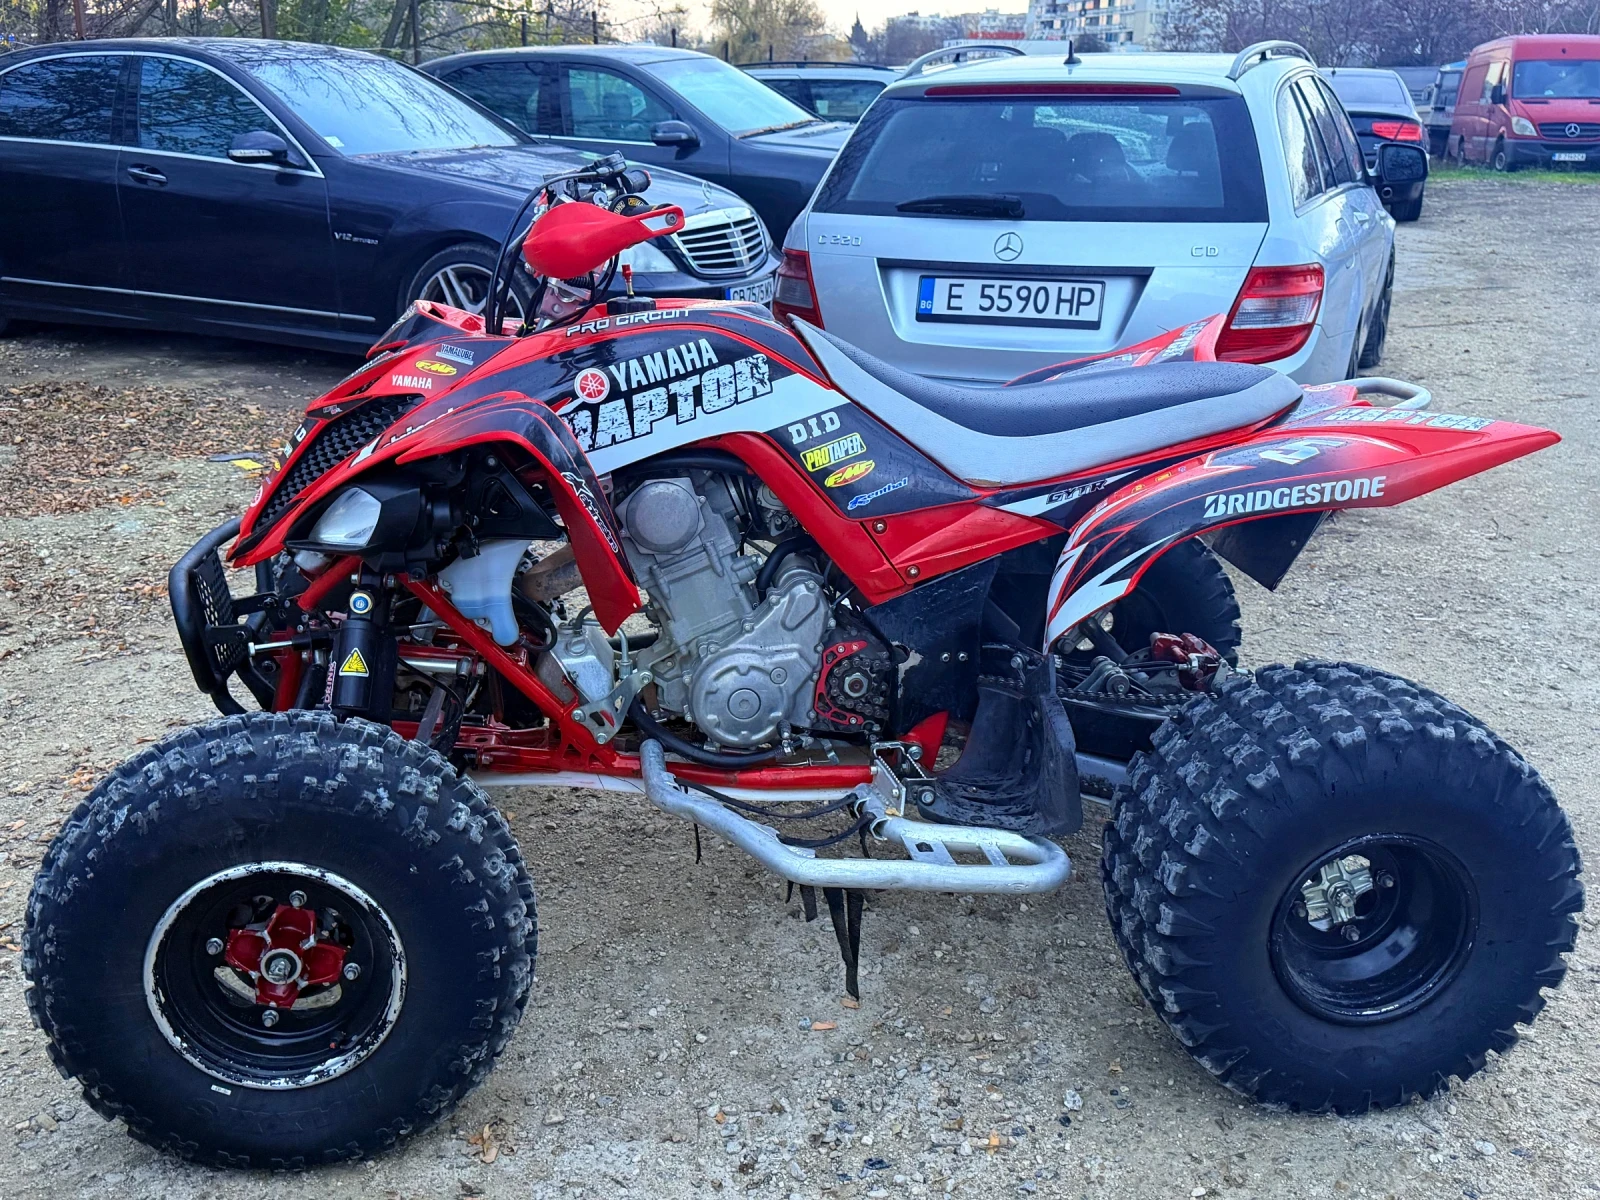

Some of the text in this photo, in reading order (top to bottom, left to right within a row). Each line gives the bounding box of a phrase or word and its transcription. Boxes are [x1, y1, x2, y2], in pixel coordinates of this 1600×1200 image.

[830, 234, 861, 247] 220
[920, 300, 932, 310] BG
[946, 283, 1096, 316] E 5590 HP
[566, 318, 610, 337] PRO
[608, 338, 718, 392] YAMAHA
[391, 374, 432, 389] YAMAHA
[787, 411, 841, 445] D.I.D
[824, 460, 875, 488] FMF
[1202, 475, 1387, 519] BRIDGESTONE
